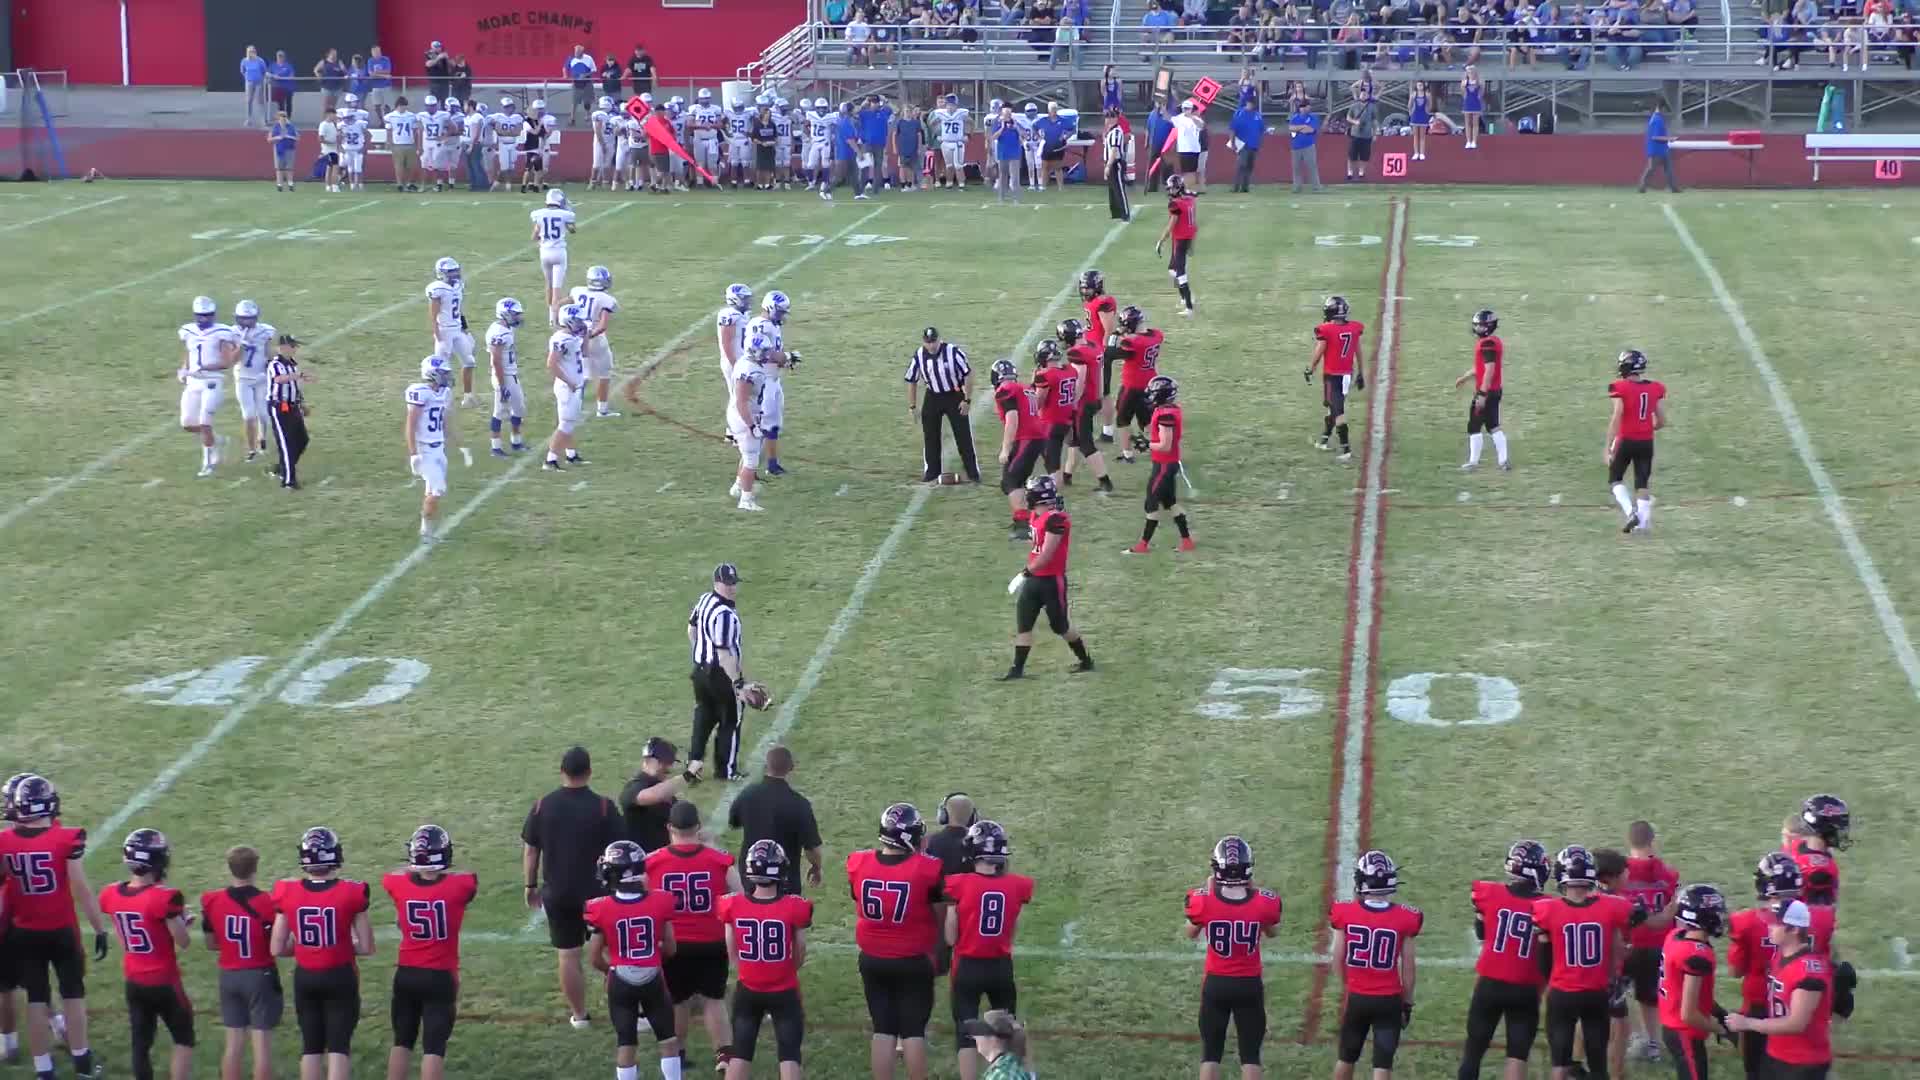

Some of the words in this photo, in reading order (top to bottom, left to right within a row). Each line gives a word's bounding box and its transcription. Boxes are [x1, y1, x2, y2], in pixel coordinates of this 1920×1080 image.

[477, 12, 521, 32] MOAC
[527, 11, 593, 34] CHAMPS
[1386, 158, 1403, 173] 50
[1881, 160, 1898, 176] 40
[543, 217, 562, 240] 15
[451, 298, 460, 319] 2
[242, 345, 256, 368] 7
[1339, 332, 1352, 358] 7
[1639, 392, 1648, 420] 1
[121, 655, 432, 708] 40
[1193, 668, 1523, 727] 50
[3, 852, 57, 895] 45
[663, 871, 711, 913] 56
[406, 899, 448, 941] 51
[861, 878, 911, 923] 67
[979, 891, 1006, 936] 8
[115, 911, 153, 954] 15
[225, 915, 250, 959] 4
[297, 906, 337, 948] 61
[616, 915, 656, 960] 13
[736, 918, 786, 962] 38
[1207, 919, 1261, 959] 84
[1345, 924, 1398, 971] 20
[1493, 908, 1534, 959] 19
[1563, 921, 1603, 968] 10
